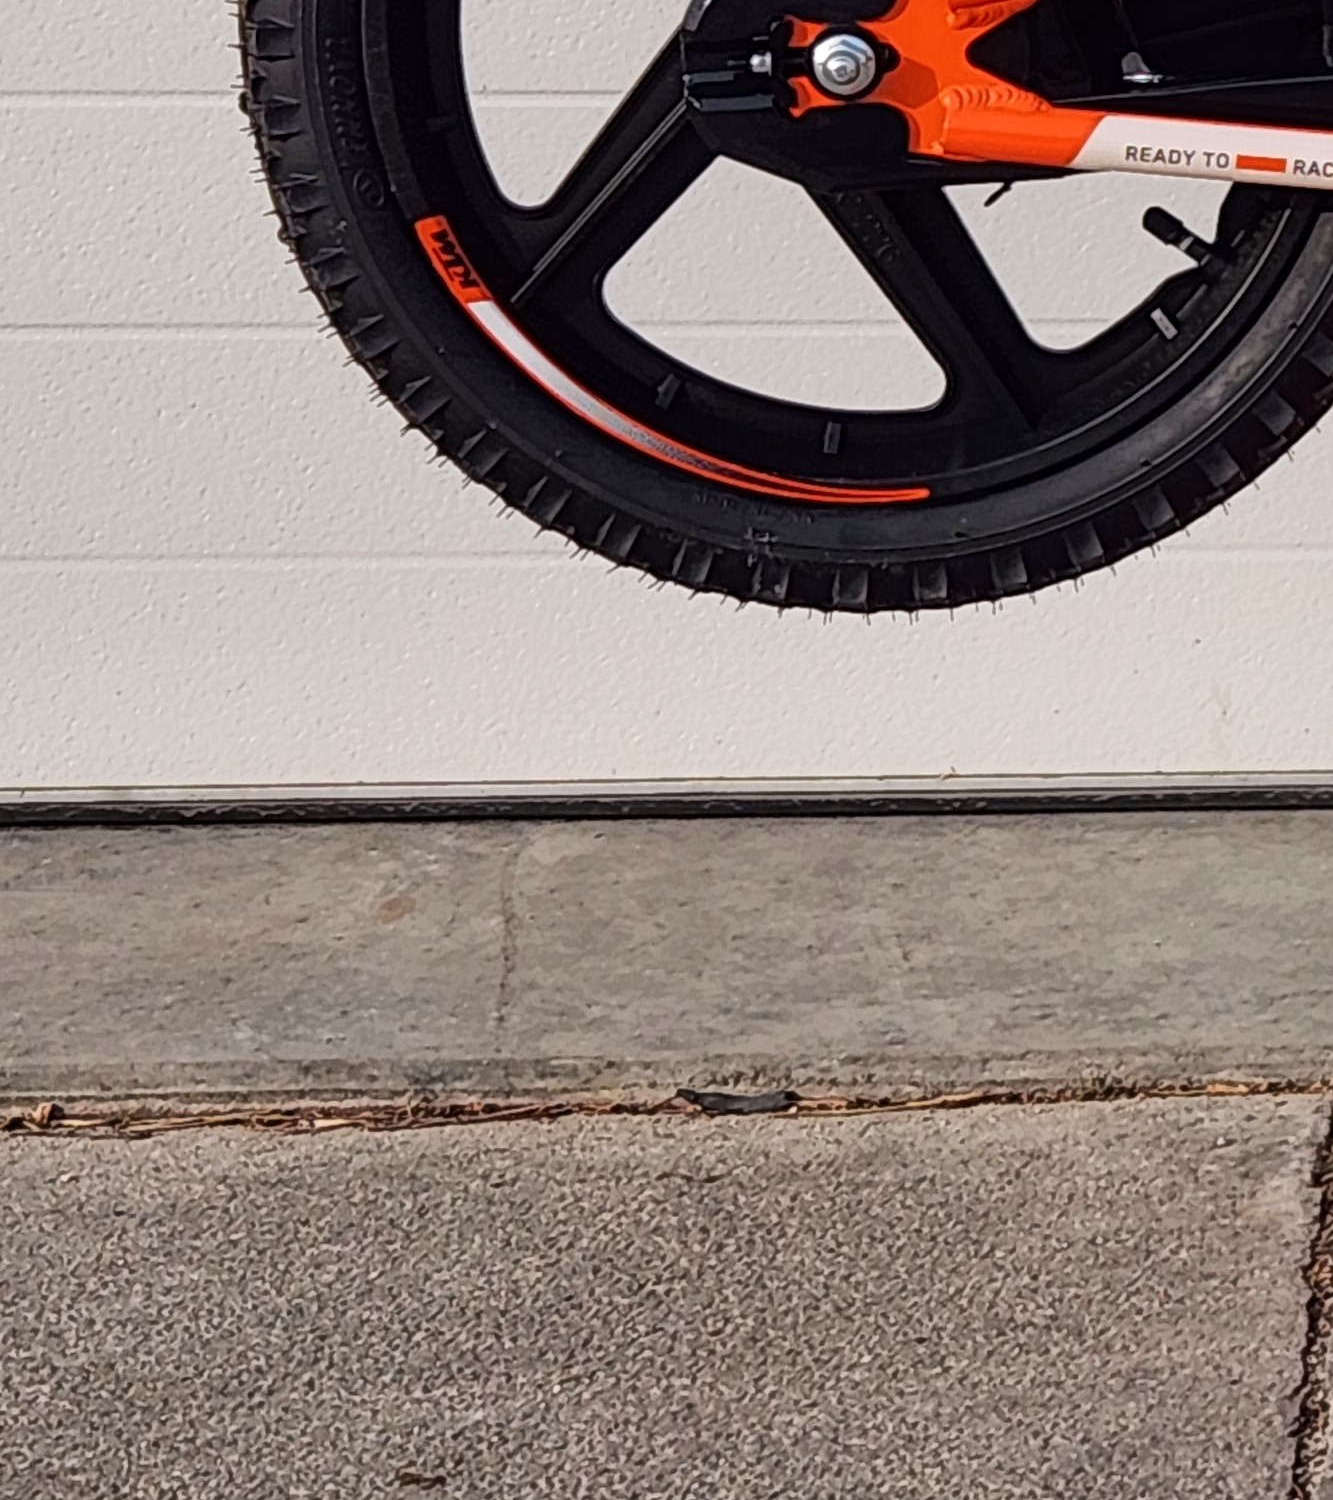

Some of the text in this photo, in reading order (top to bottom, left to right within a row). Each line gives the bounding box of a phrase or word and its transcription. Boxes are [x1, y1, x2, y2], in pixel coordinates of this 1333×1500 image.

[1125, 145, 1196, 166] READY
[1202, 151, 1230, 169] TO
[430, 227, 484, 290] KTM
